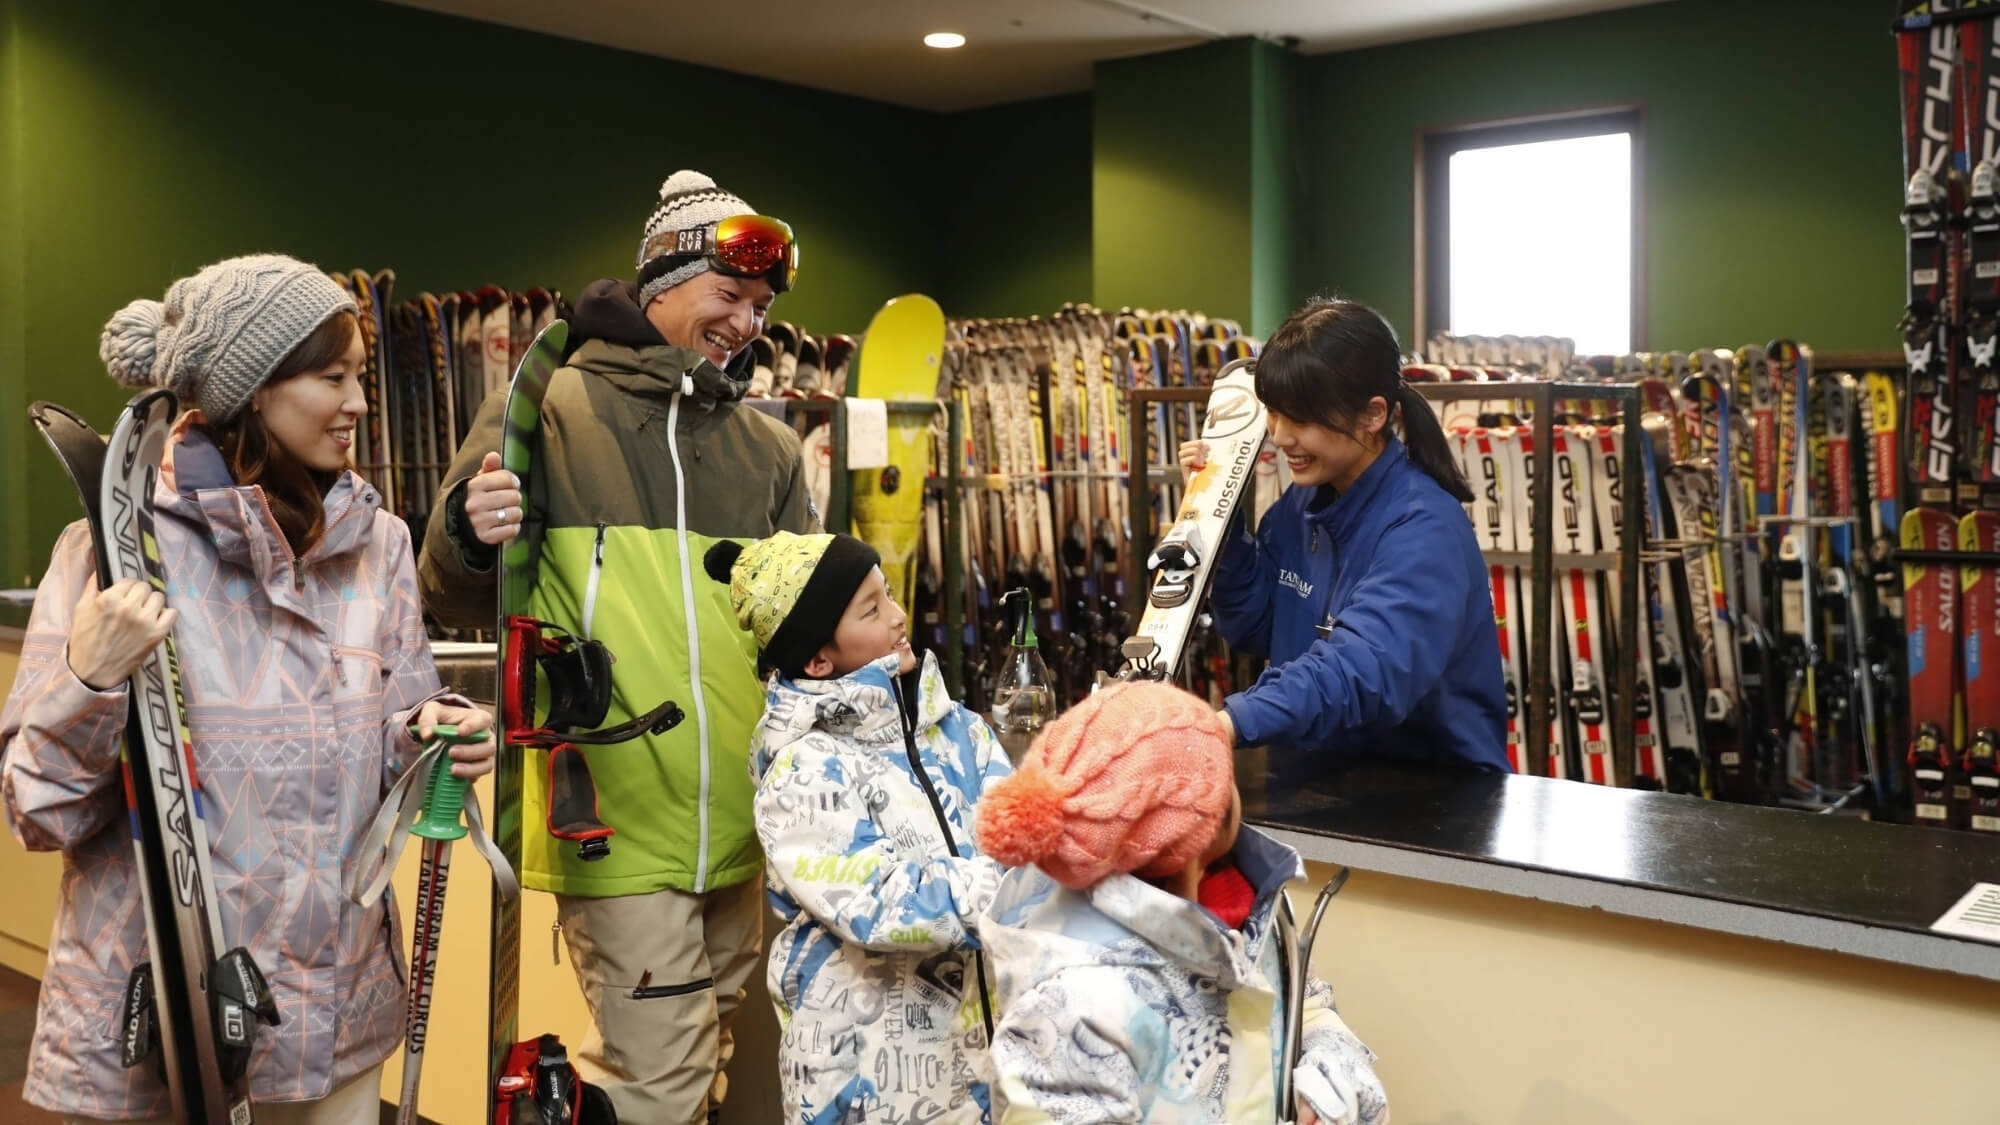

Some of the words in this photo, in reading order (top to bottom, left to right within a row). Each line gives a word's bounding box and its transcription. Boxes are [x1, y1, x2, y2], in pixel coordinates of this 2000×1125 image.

[678, 241, 702, 251] LVR
[679, 231, 703, 241] QKS
[1213, 437, 1256, 519] ROSSIGNOL
[1481, 456, 1501, 551] HEAD
[1557, 456, 1581, 554] HEAD
[1936, 522, 1955, 632] SALOON
[425, 863, 450, 952] TANGRAM
[421, 959, 435, 988] SKI
[410, 993, 431, 1055] CIRCUS
